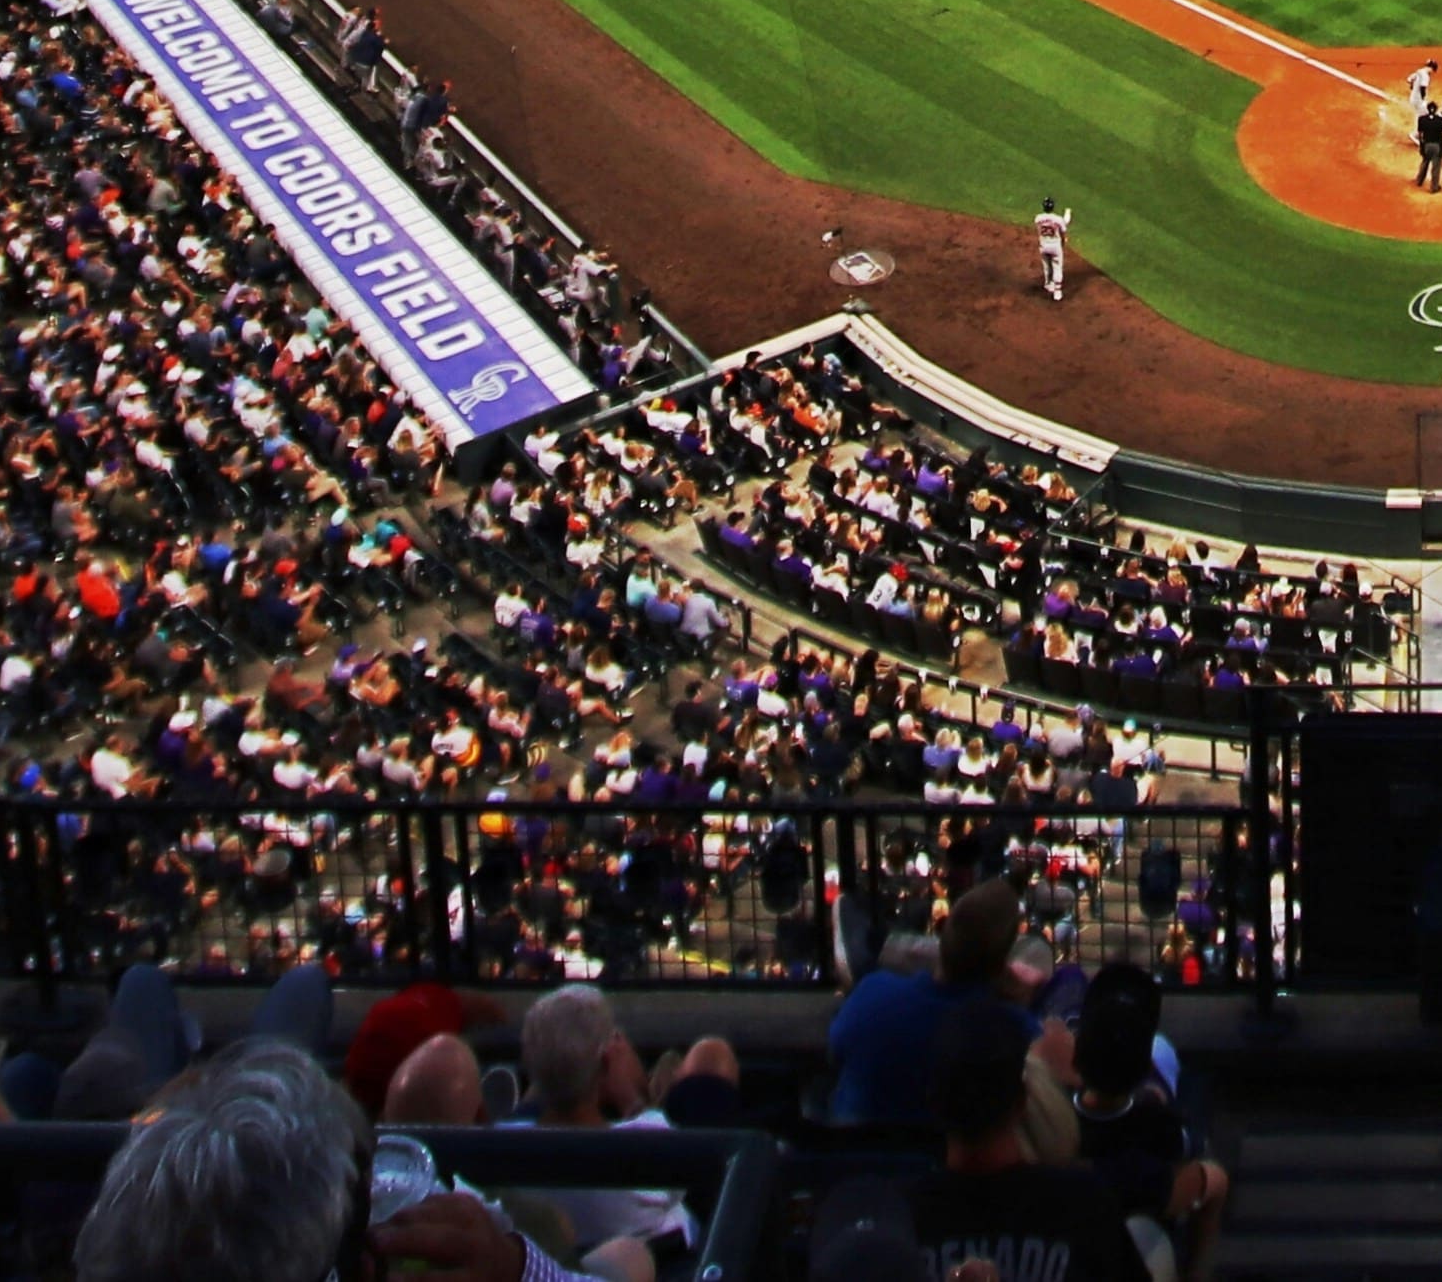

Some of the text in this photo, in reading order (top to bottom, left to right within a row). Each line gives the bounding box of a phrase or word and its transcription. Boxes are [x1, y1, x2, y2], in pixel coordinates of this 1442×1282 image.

[231, 96, 299, 152] TO
[265, 145, 391, 257] COORS
[355, 250, 486, 362] FIELD
